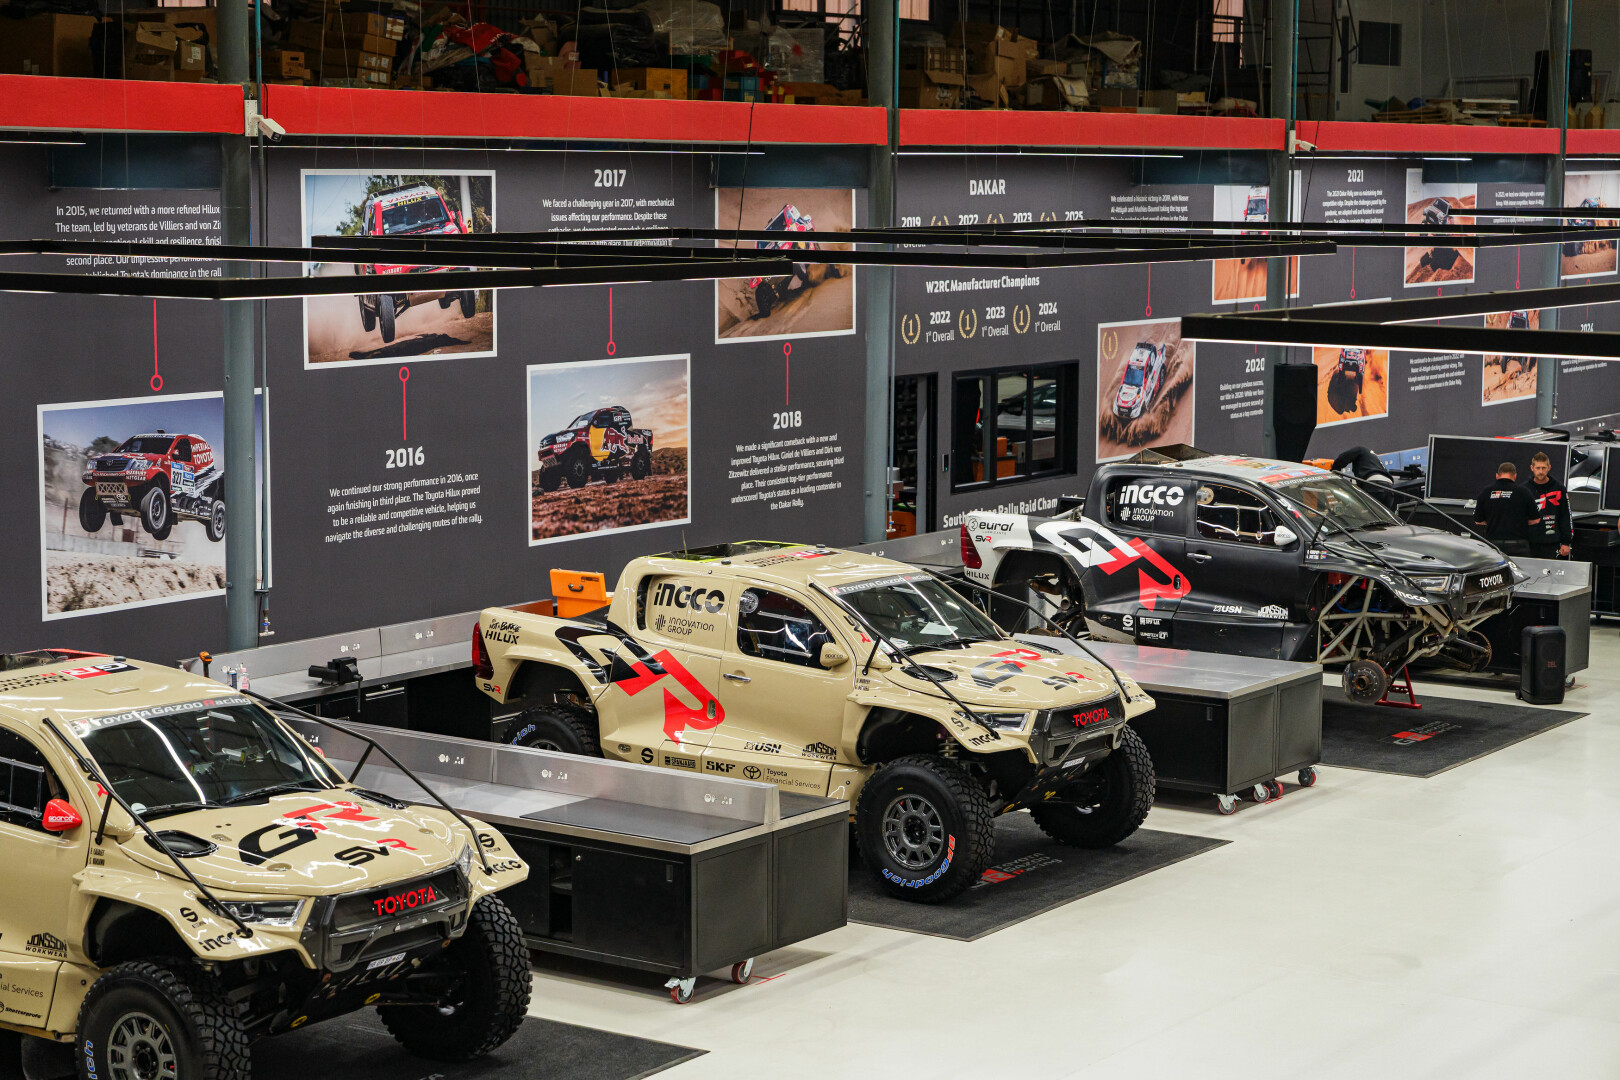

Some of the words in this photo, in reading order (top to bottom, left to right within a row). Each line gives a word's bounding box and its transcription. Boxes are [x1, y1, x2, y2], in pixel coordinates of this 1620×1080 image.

[594, 169, 626, 187] 2017
[1348, 170, 1363, 182] 2021
[970, 179, 1005, 196] DAKAR
[553, 199, 568, 208] faced
[573, 199, 601, 209] challenging
[603, 200, 614, 209] year
[621, 199, 635, 208] 2017,
[648, 198, 674, 206] mechanical
[56, 206, 64, 216] In
[66, 206, 87, 217] 2015,
[101, 206, 132, 215] returned
[134, 205, 149, 215] with
[177, 205, 200, 214] refined
[202, 204, 220, 214] Hilux
[551, 213, 567, 221] issues
[568, 213, 590, 222] affecting
[601, 212, 633, 222] performance.
[634, 212, 652, 221] Despite
[1065, 211, 1084, 220] 2025
[902, 217, 921, 227] 2019
[959, 215, 978, 225] 2022
[1013, 213, 1032, 223] 2023
[55, 223, 70, 232] The
[72, 223, 92, 233] team,
[94, 222, 104, 231] led
[106, 222, 116, 234] by
[118, 223, 148, 231] veterans
[149, 221, 158, 230] de
[159, 221, 183, 230] Villiers
[185, 220, 198, 230] and
[199, 221, 211, 229] von
[67, 256, 91, 265] second
[93, 256, 114, 267] place.
[151, 268, 188, 278] dominance
[190, 268, 196, 278] in
[198, 268, 209, 277] the
[926, 280, 950, 293] W2RC
[951, 278, 1000, 292] Manufacturer
[1001, 275, 1039, 289] Champions
[986, 306, 1005, 319] 2023
[1038, 302, 1057, 315] 2024
[930, 311, 950, 324] 2022
[988, 325, 1009, 336] Overall
[1040, 320, 1061, 332] Overall
[932, 330, 954, 342] Overall
[1246, 358, 1265, 373] 2020
[773, 411, 802, 429] 2018
[385, 446, 425, 469] 2016
[330, 488, 340, 497] We
[342, 484, 371, 496] continued
[372, 483, 382, 493] our
[384, 481, 402, 492] strong
[404, 477, 439, 492] performance
[440, 476, 446, 484] in
[447, 474, 464, 484] 2016,
[465, 473, 478, 481] once
[328, 504, 344, 515] again
[346, 500, 372, 512] finishing
[380, 496, 394, 506] third
[395, 495, 412, 506] place.
[413, 492, 424, 501] The
[425, 491, 444, 502] Toyota
[446, 488, 460, 498] Hilux
[461, 485, 480, 498] proved
[998, 502, 1019, 514] Rally
[1020, 498, 1036, 514] Raid
[1037, 498, 1058, 511] Cham
[333, 519, 339, 527] to
[341, 516, 348, 526] be
[355, 513, 376, 524] reliable
[378, 511, 389, 521] and
[390, 507, 424, 521] competitive
[425, 505, 446, 514] vehicle,
[447, 502, 468, 513] helping
[469, 501, 476, 509] us
[325, 530, 351, 543] navigate
[353, 528, 363, 539] the
[364, 525, 385, 538] diverse
[386, 524, 397, 534] and
[399, 520, 431, 533] challenging
[432, 516, 450, 528] routes
[451, 515, 458, 525] of
[459, 514, 468, 524] the
[469, 514, 483, 524] rally.
[979, 521, 1014, 532] eurol
[966, 570, 989, 580] HILUX
[1480, 574, 1503, 588] TOYOTA
[1221, 605, 1242, 614] USN
[1260, 604, 1288, 616] JONSSON
[667, 625, 692, 635] GROUP
[485, 630, 520, 645] HILUX
[92, 711, 150, 726] TOYOTA
[152, 701, 203, 715] GAZOO
[203, 697, 251, 707] Racing
[1073, 707, 1109, 727] TOYOTA
[754, 742, 782, 754] USN
[802, 742, 837, 756] JONSSON
[706, 760, 735, 773] SKF
[766, 768, 787, 777] Toyota
[766, 775, 793, 786] Financial
[795, 779, 821, 790] Services
[374, 886, 436, 916] TOYOTA
[27, 932, 67, 951] JONSSON
[26, 946, 68, 958] WORKWEAR
[12, 984, 43, 998] Services
